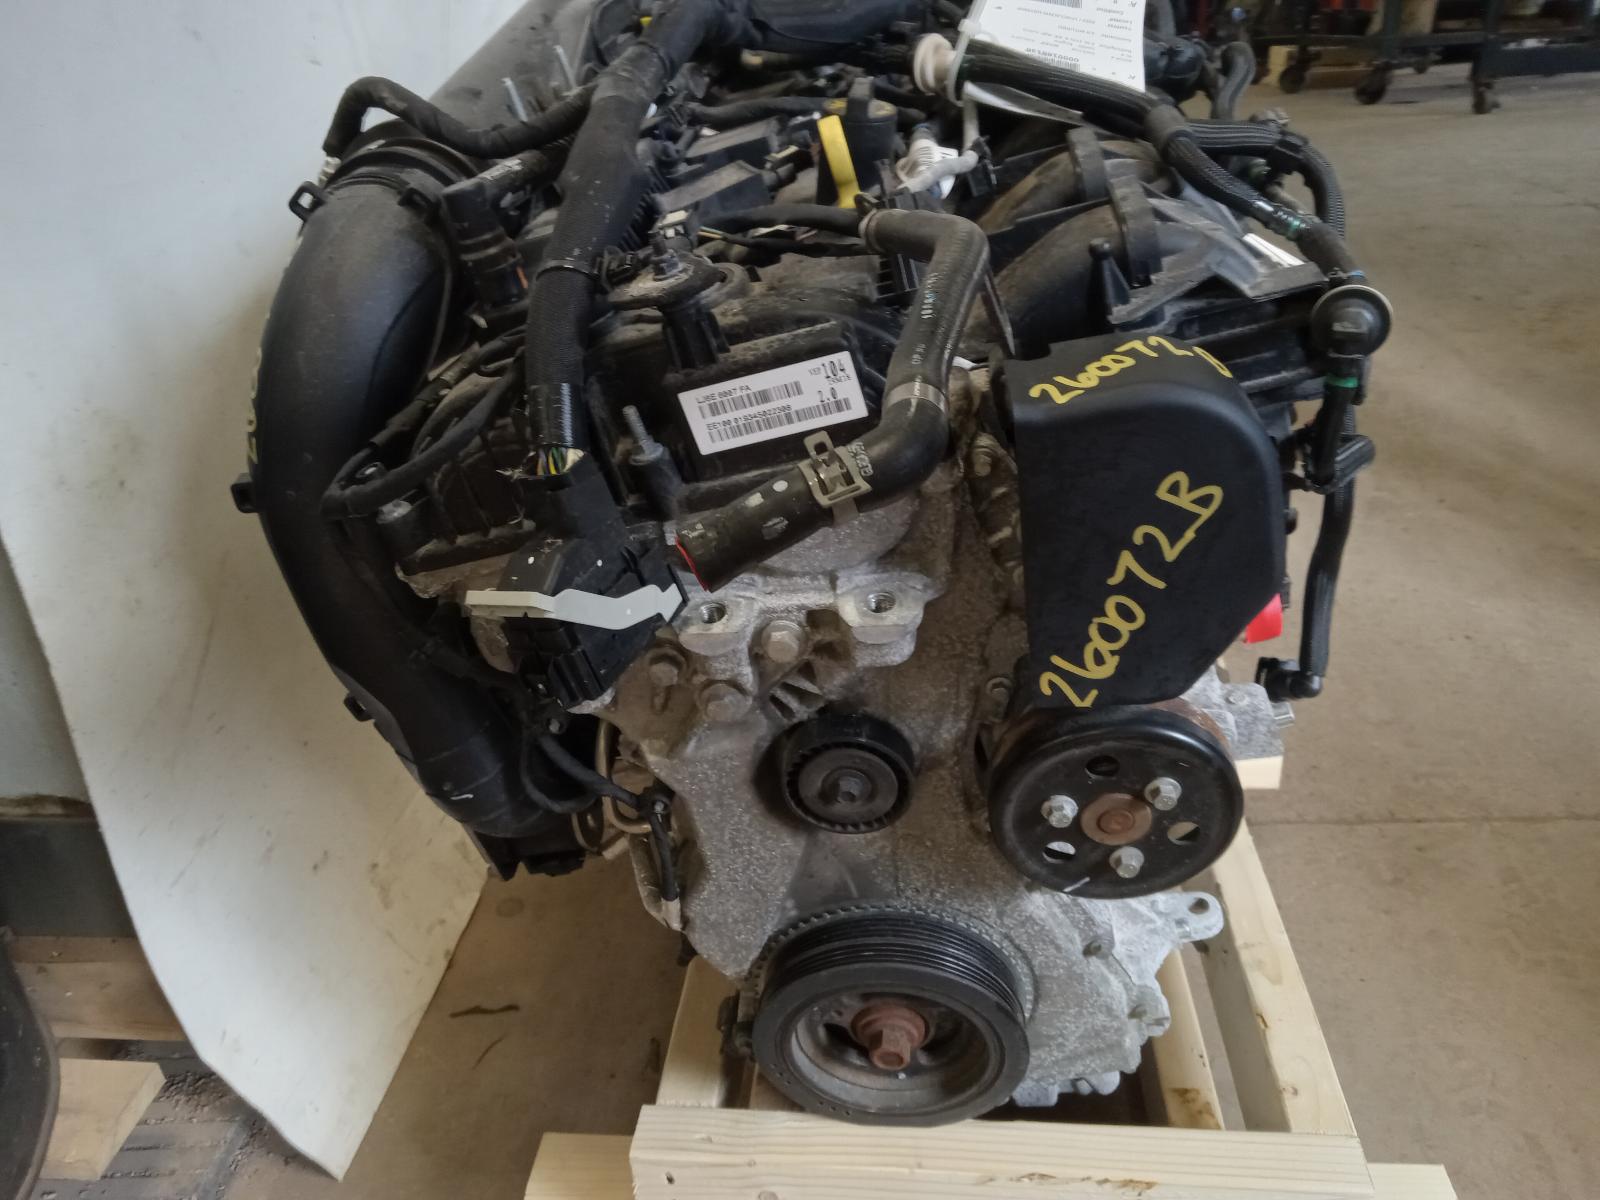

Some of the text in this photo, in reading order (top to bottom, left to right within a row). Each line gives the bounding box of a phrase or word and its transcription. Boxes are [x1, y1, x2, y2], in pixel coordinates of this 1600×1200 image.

[821, 360, 848, 380] 104
[817, 386, 838, 403] 2.0
[1039, 471, 1223, 708] 260072B
